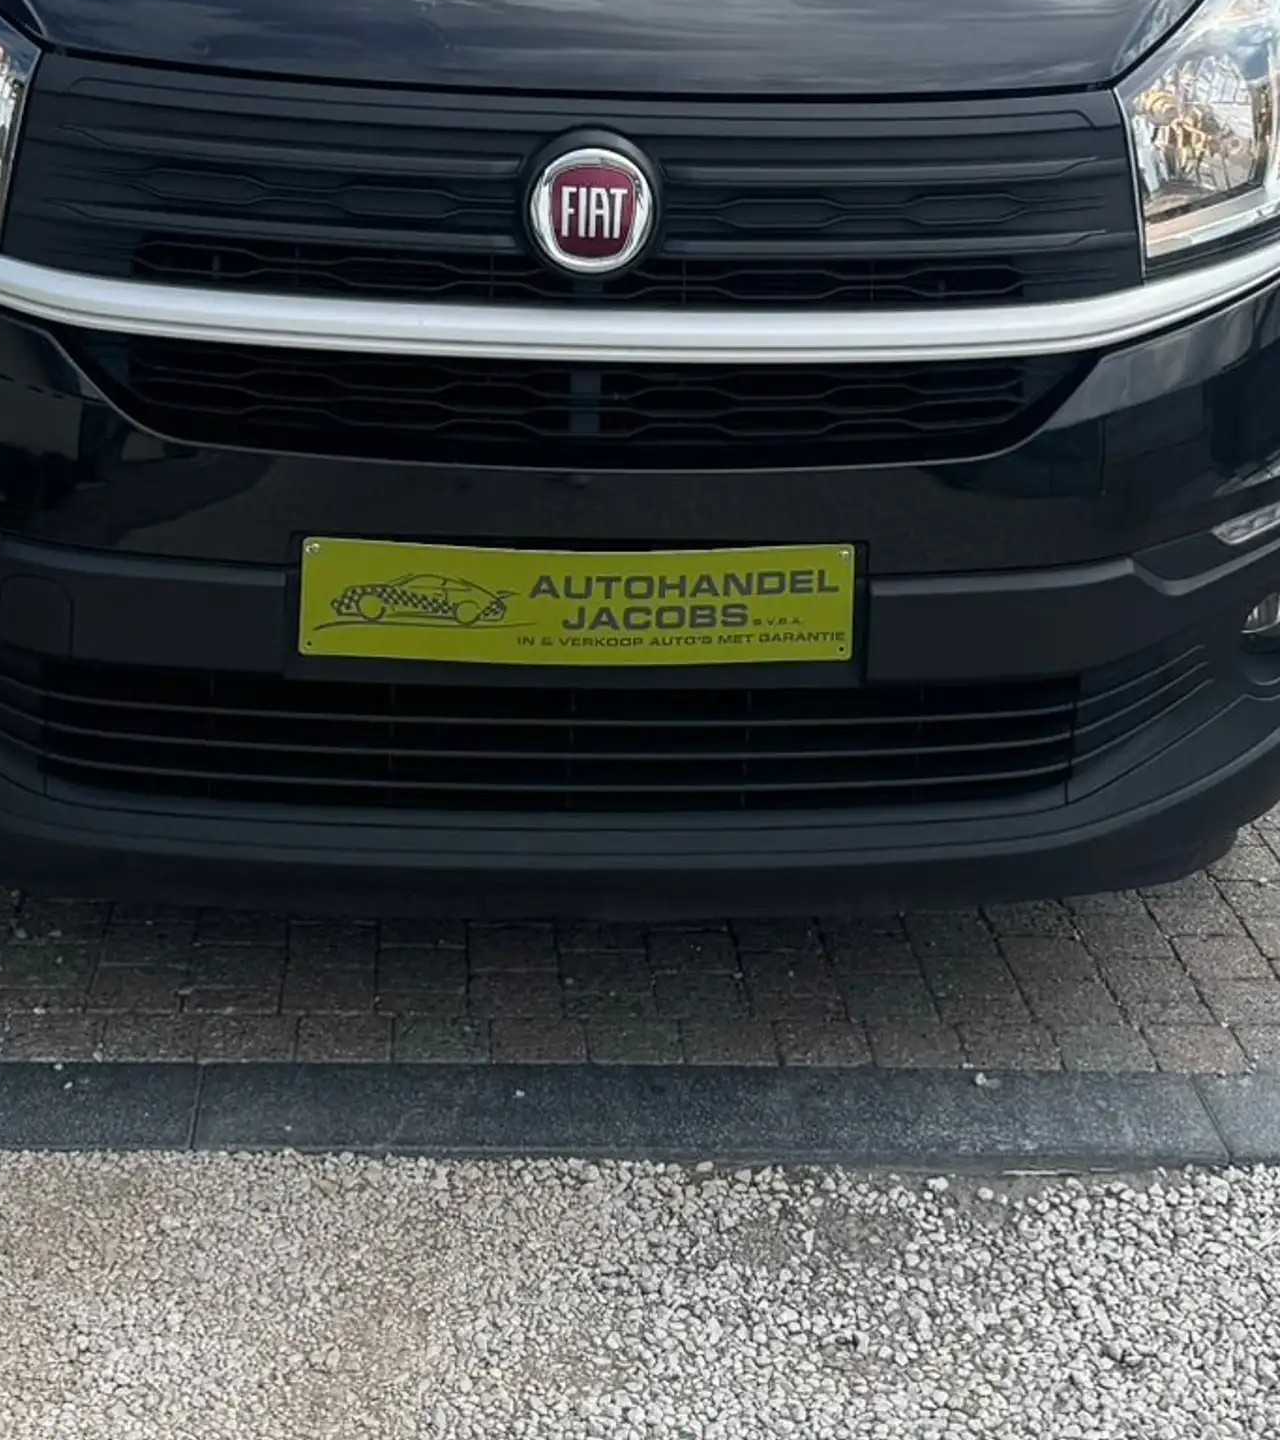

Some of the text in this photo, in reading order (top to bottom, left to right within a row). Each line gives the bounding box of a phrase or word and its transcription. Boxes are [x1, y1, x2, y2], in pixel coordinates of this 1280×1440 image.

[561, 186, 629, 239] FIAT
[529, 569, 840, 600] AUTOHANDEL
[562, 603, 748, 630] JACOBS
[516, 631, 845, 648] IN & VERKOOP AUTO'S MET GARANTIE
